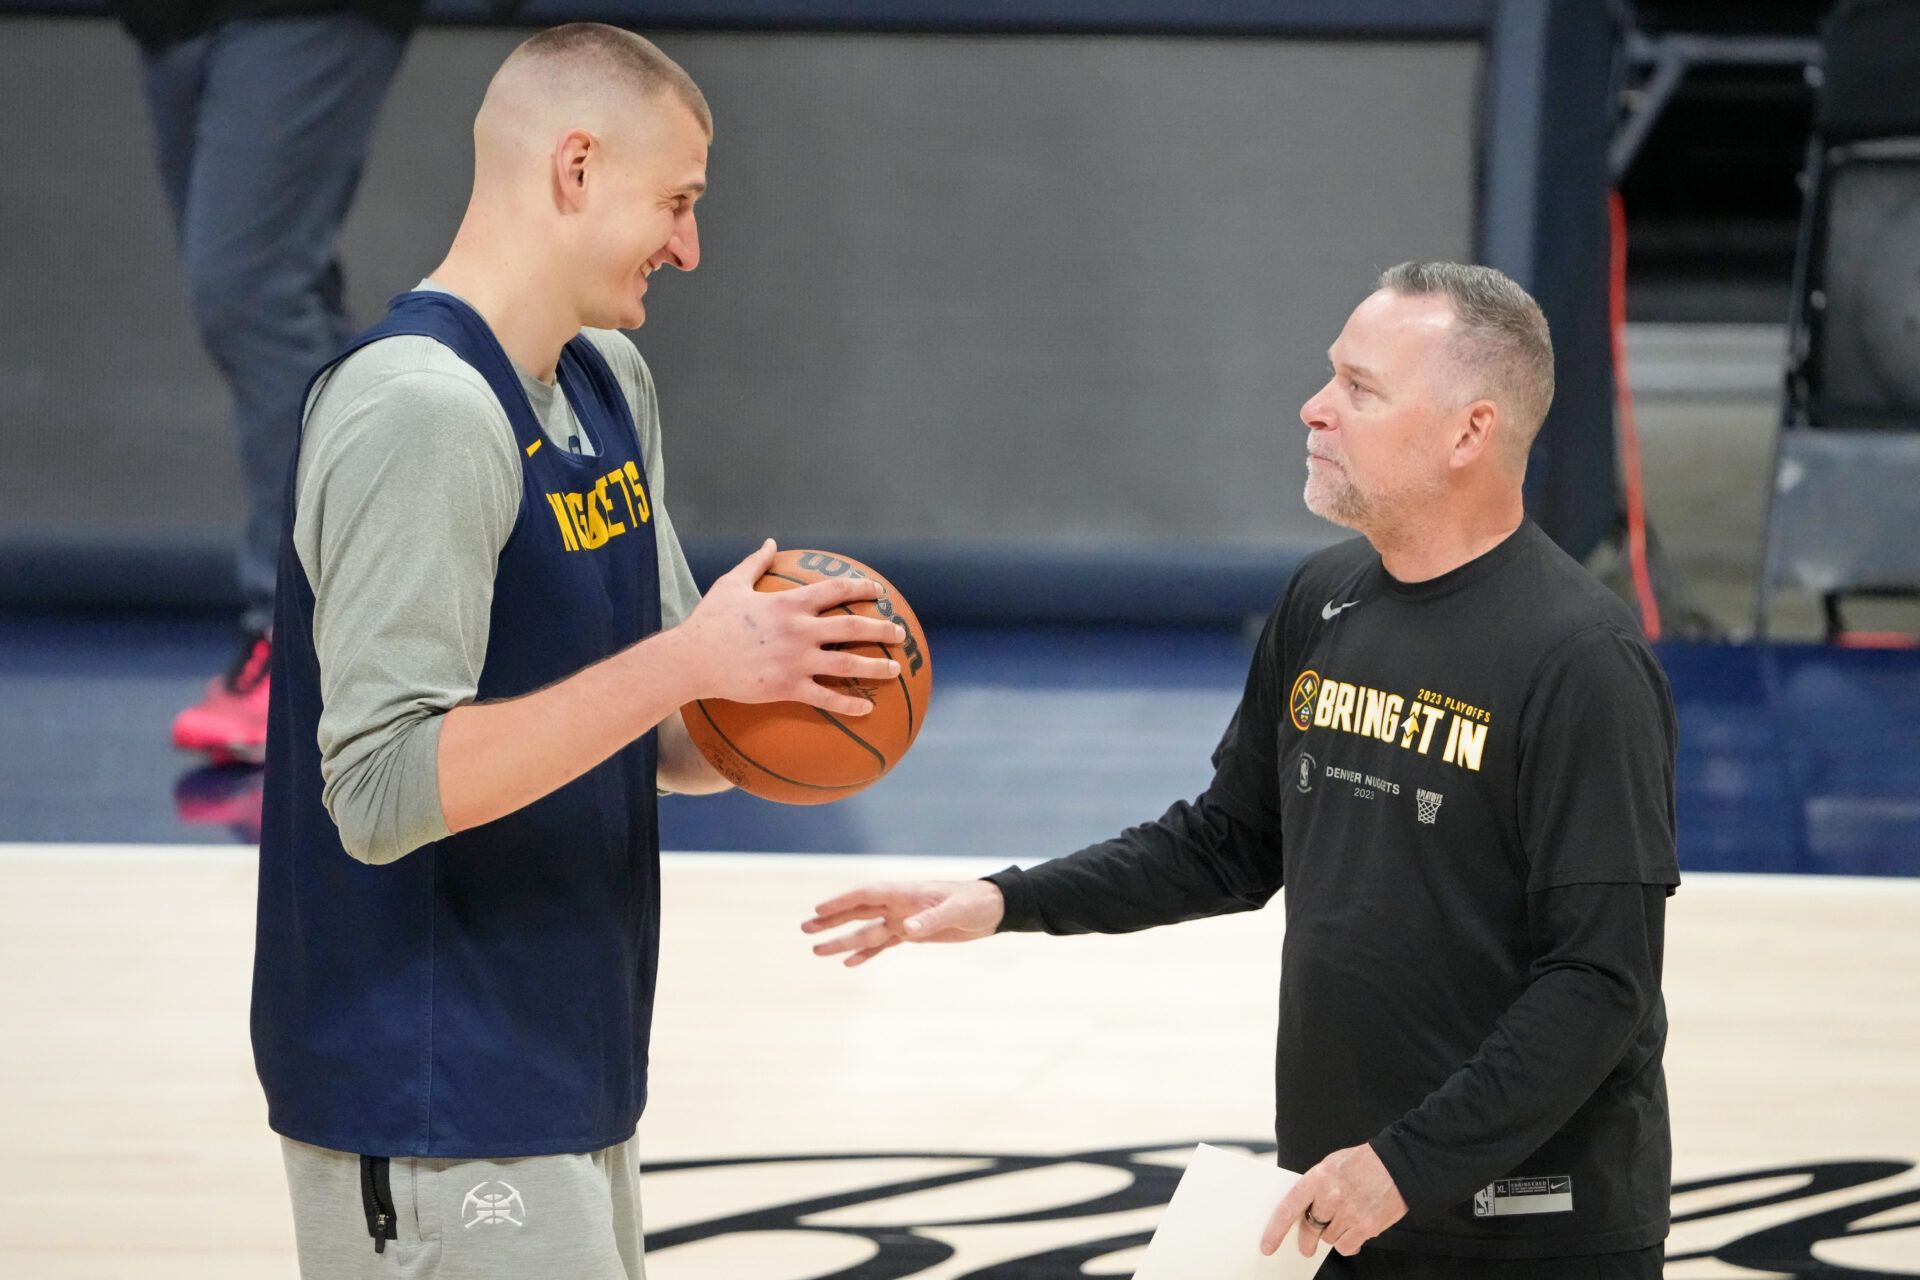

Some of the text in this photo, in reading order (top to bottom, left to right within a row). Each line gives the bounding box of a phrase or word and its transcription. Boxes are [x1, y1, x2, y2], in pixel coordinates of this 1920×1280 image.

[545, 460, 650, 552] NGGETS
[796, 551, 923, 678] Wson
[1417, 688, 1491, 723] 2023 PLAYOFFS
[1314, 678, 1489, 772] BRING IT IN
[1326, 766, 1401, 795] DENVER NUGGETS
[1353, 786, 1376, 800] 2023
[1496, 1184, 1507, 1194] XL
